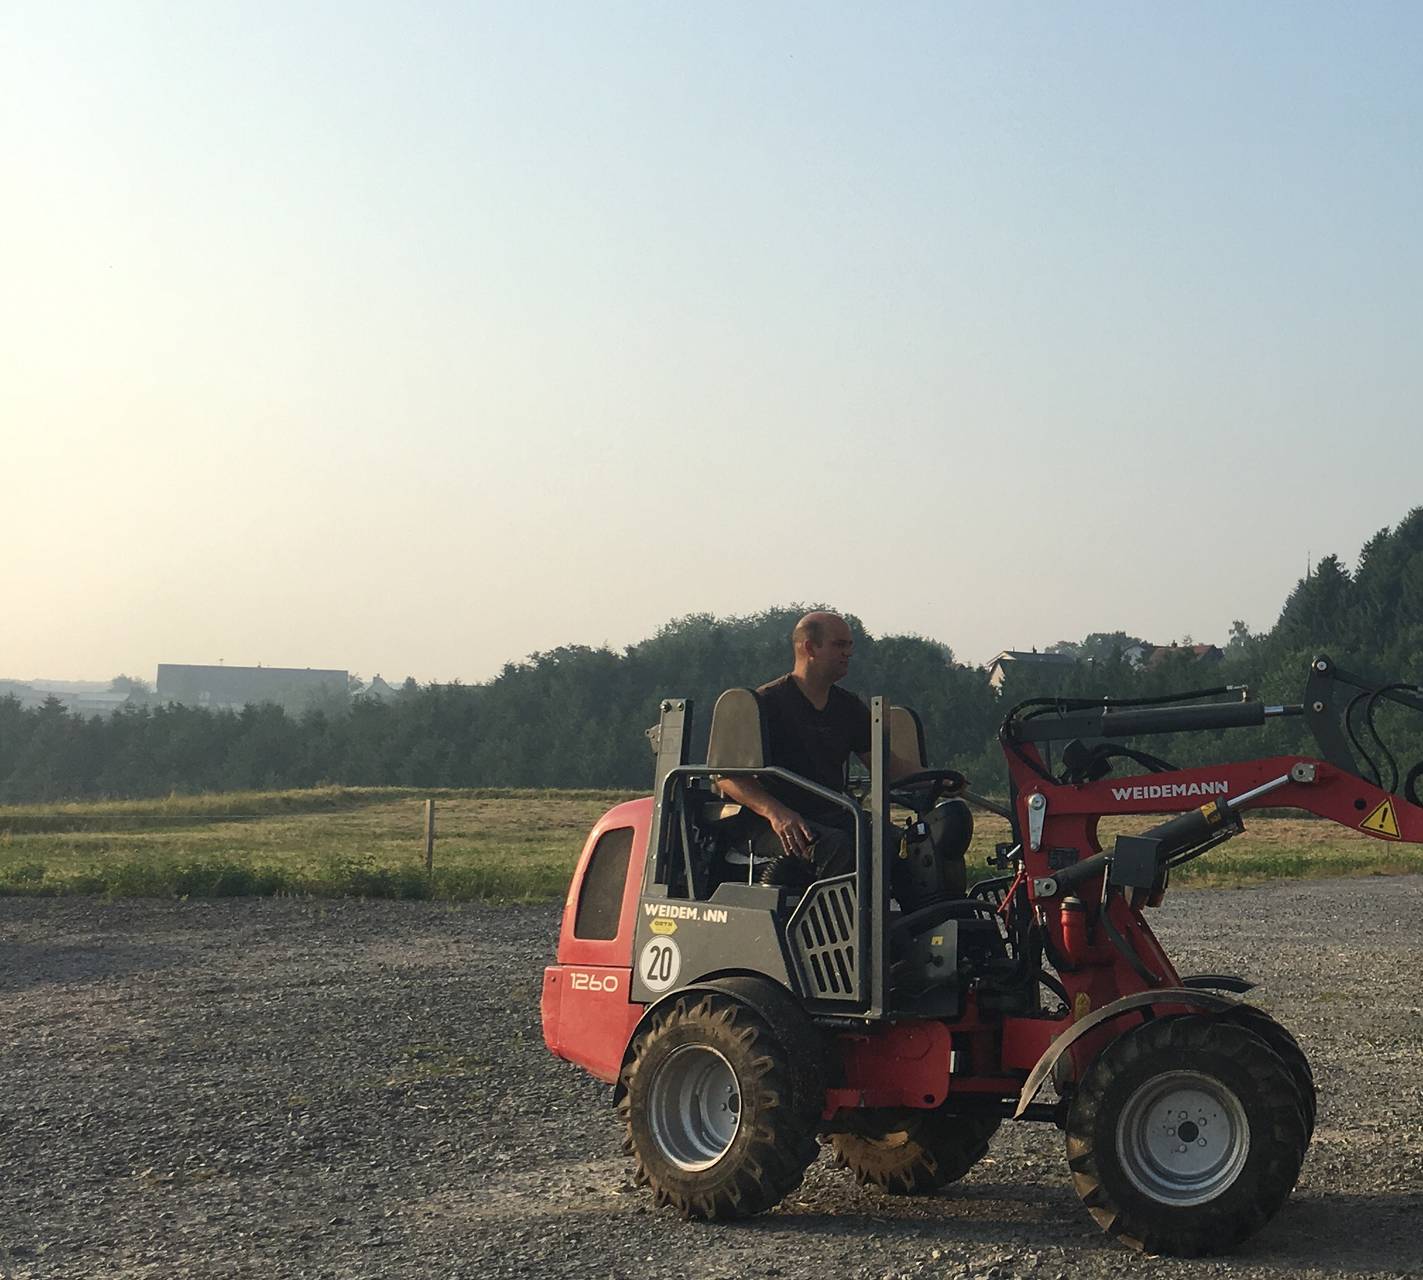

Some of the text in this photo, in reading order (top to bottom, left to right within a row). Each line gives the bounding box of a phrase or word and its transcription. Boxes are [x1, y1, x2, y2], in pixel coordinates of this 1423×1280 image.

[1111, 781, 1228, 800] WEIDEMANN
[646, 945, 673, 982] 20
[570, 973, 618, 992] 1260
